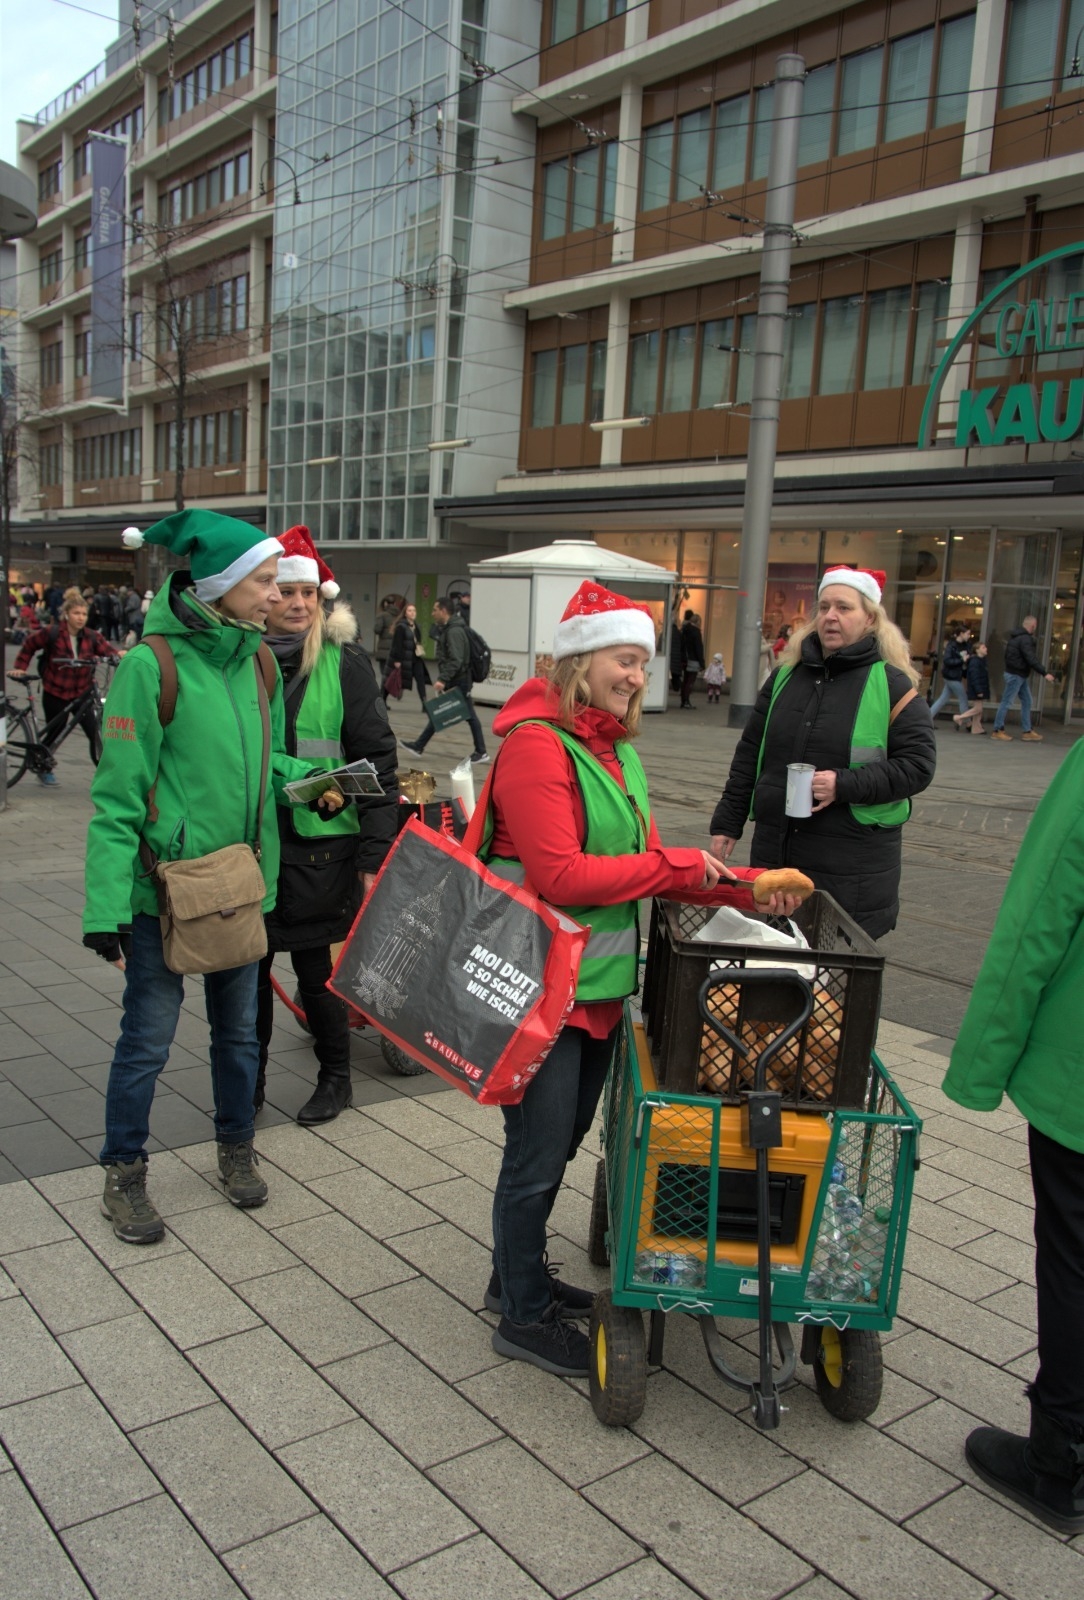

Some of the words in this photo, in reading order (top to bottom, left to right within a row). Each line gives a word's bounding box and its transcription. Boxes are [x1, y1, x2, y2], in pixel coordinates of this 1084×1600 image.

[99, 187, 110, 243] GALERIA
[462, 959, 477, 974] IS
[473, 967, 492, 983] SO
[489, 977, 529, 1008] SCHÄÄ
[469, 943, 503, 971] MOI
[499, 961, 540, 995] DUTT
[466, 979, 490, 1001] WIE
[486, 993, 520, 1020] ISCH!
[432, 1039, 481, 1079] BAUHAUS
